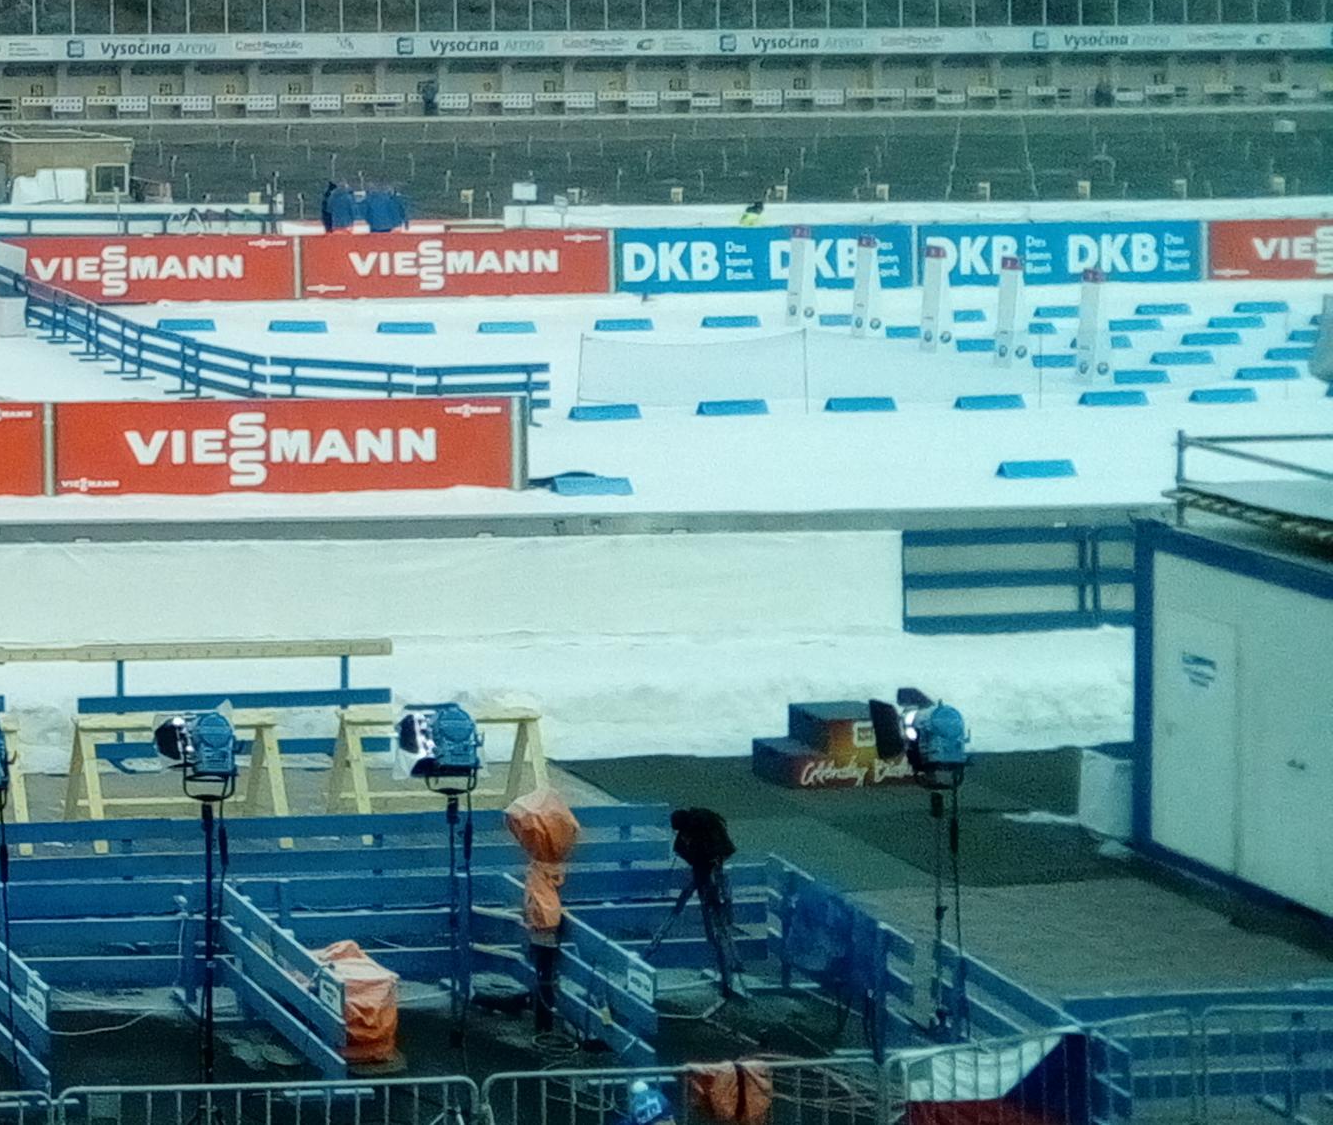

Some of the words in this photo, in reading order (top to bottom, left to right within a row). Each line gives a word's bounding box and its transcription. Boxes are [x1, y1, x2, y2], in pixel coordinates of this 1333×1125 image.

[100, 38, 171, 58] Vysočina
[175, 41, 217, 55] Arena
[348, 239, 560, 291] VIESSMANN
[623, 240, 720, 282] DKB
[725, 241, 747, 254] Das
[1068, 232, 1159, 273] DKB
[1252, 225, 1333, 274] VIESS
[31, 244, 244, 297] VIESSMANN
[123, 411, 437, 488] VIESSMANN
